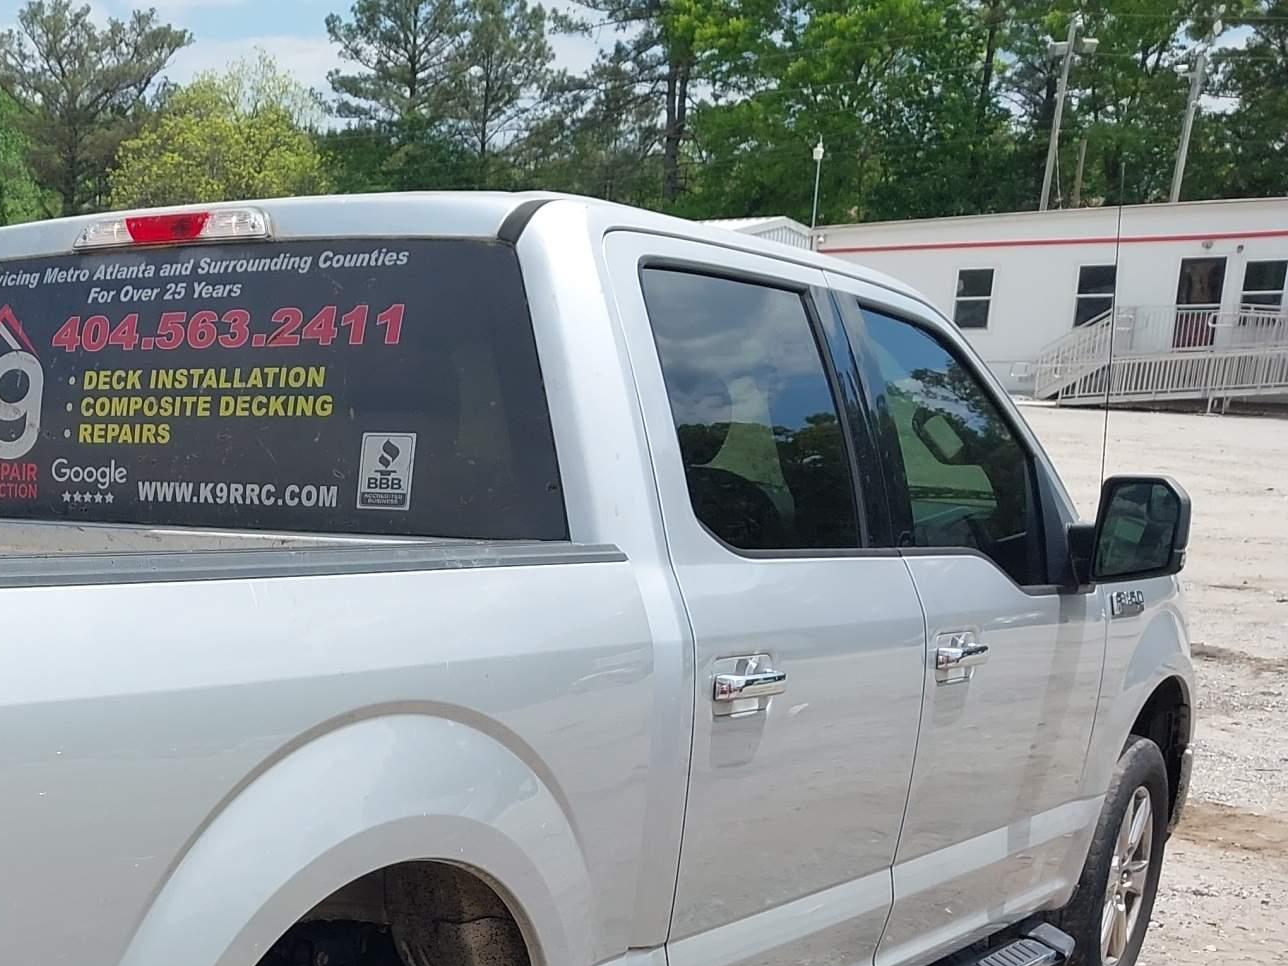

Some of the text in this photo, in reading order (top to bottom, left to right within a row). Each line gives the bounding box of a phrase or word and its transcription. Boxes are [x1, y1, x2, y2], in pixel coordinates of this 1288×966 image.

[43, 266, 92, 285] Metro
[93, 261, 156, 281] Atlanta
[160, 259, 194, 277] and
[197, 253, 312, 275] Surrounding
[318, 248, 410, 270] Counties
[87, 281, 243, 304] For Over 25 Years
[51, 303, 406, 353] 404.563.2411
[83, 366, 326, 390] DECK INSTALLATION
[80, 395, 334, 417] COMPOSITE DECKING
[78, 423, 171, 444] REPAIRS
[51, 458, 128, 490] Google
[367, 477, 402, 490] BBB
[137, 480, 339, 508] WWW.K9RRC.COM
